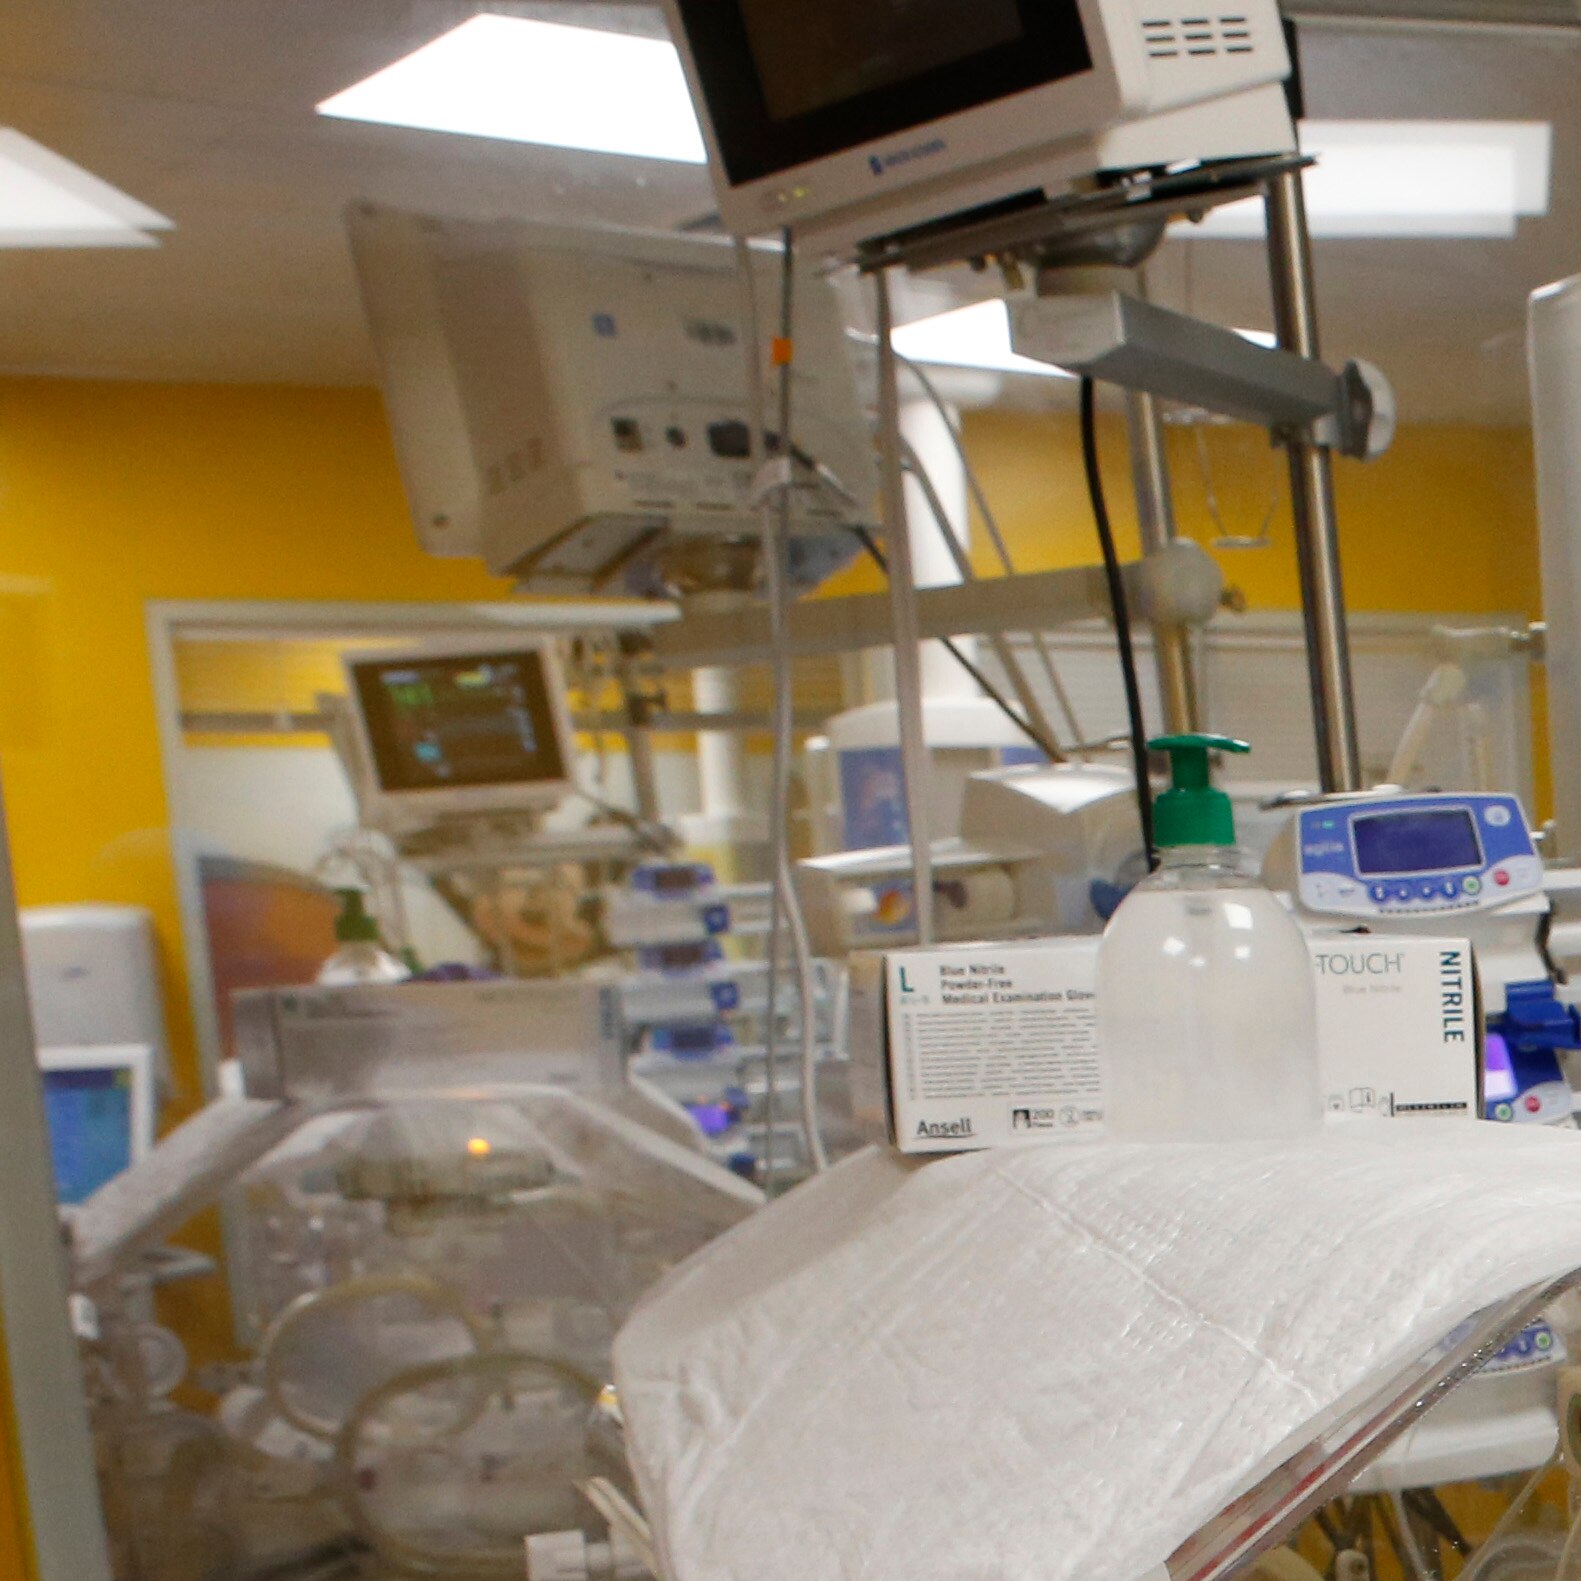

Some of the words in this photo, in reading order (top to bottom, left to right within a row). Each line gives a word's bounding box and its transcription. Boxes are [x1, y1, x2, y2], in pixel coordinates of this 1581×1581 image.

[899, 965, 915, 992] L
[1440, 951, 1466, 1043] NITRILE
[917, 1117, 973, 1136] Ansell
